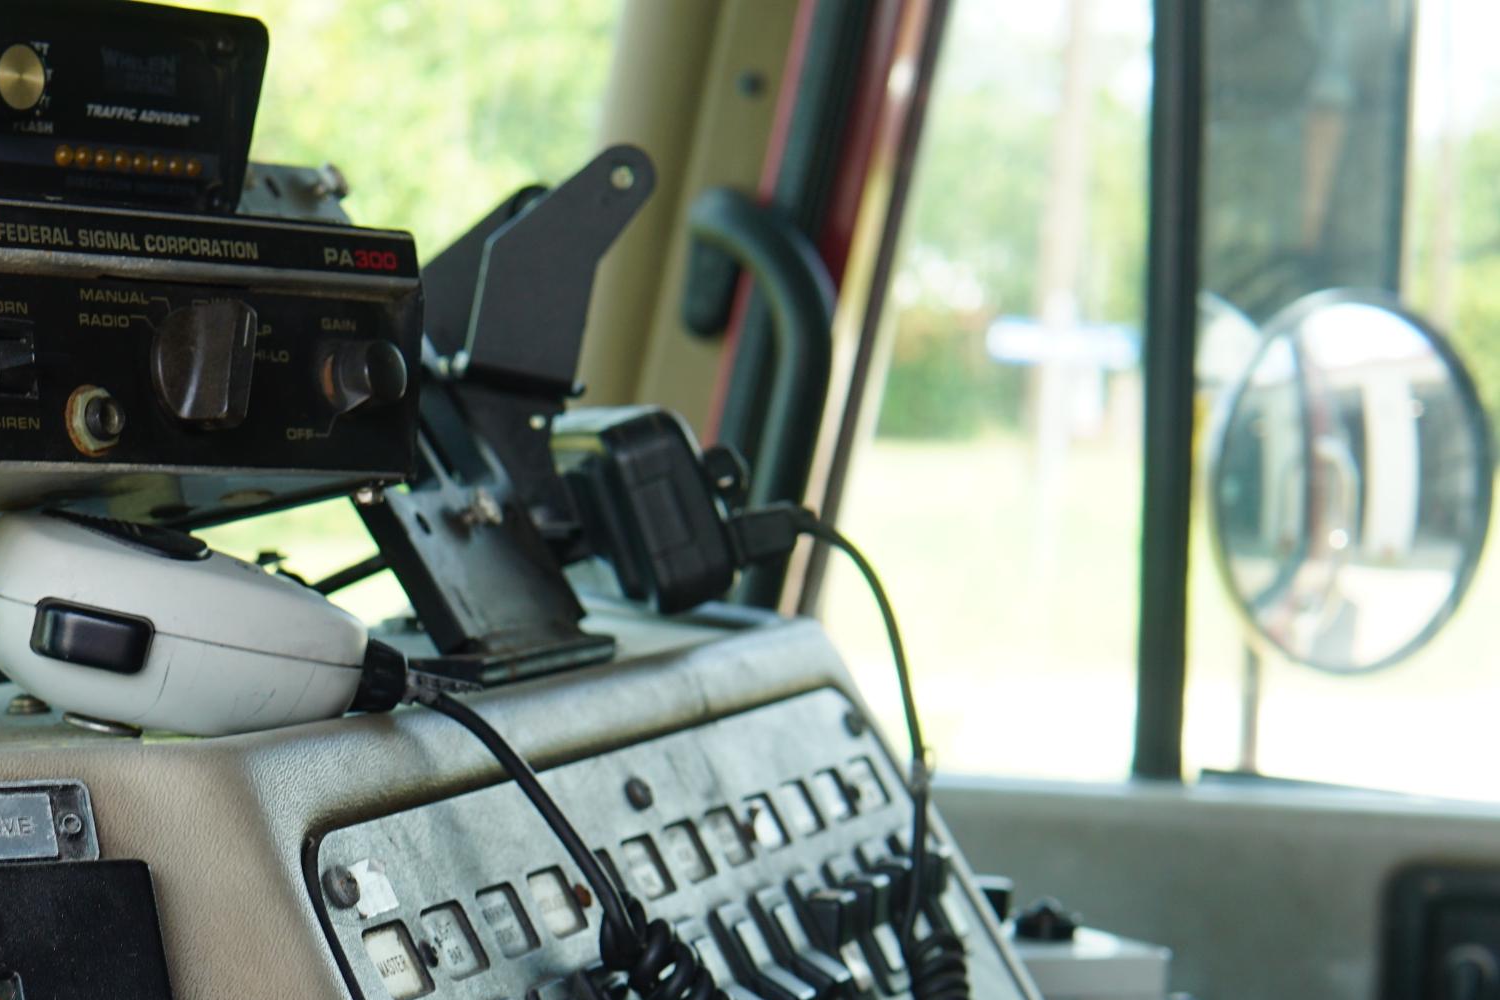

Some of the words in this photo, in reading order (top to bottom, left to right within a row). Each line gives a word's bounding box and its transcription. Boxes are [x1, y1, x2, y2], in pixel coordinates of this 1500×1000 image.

[86, 103, 136, 122] TRAFFIC
[78, 229, 140, 252] SIGNAL
[144, 233, 259, 261] CORPORATION
[323, 247, 398, 271] PA300
[79, 288, 149, 305] MANUAL
[78, 313, 130, 329] RADIO
[320, 317, 357, 332] GAIN
[286, 427, 315, 441] OFF
[376, 954, 406, 978] MASTER
